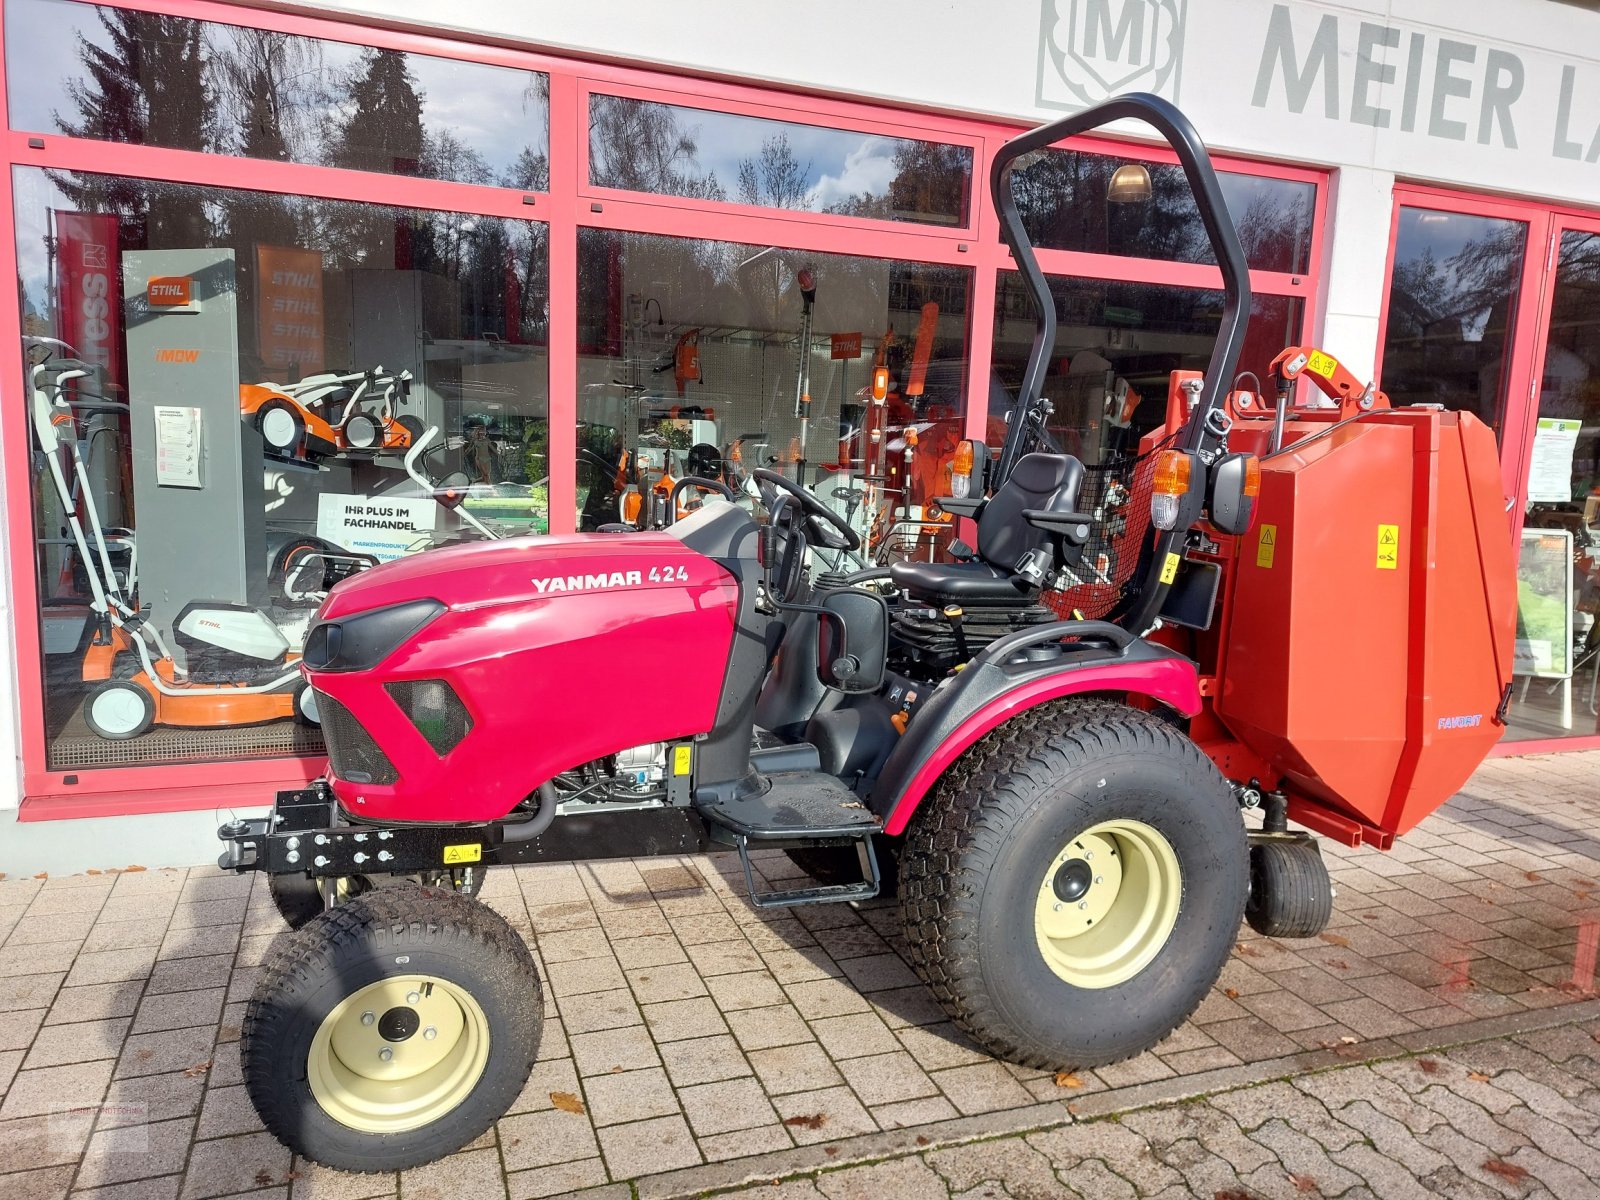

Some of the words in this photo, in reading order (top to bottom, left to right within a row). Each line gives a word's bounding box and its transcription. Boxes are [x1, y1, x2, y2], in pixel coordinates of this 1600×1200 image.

[1251, 4, 1525, 150] MEIER
[272, 269, 320, 290] STIHL
[151, 284, 184, 296] STIHL
[272, 299, 320, 316] STIHL
[272, 323, 320, 339] STIHL
[834, 341, 857, 352] STIHL
[272, 346, 320, 364] STIHL
[345, 505, 363, 515] IHR
[366, 506, 393, 517] PLUS
[396, 508, 410, 518] IM
[344, 518, 416, 530] FACHHANDEL
[532, 570, 641, 594] YANMAR
[648, 565, 689, 583] 424
[198, 619, 221, 629] STIHL
[1438, 714, 1482, 730] FAVORIT
